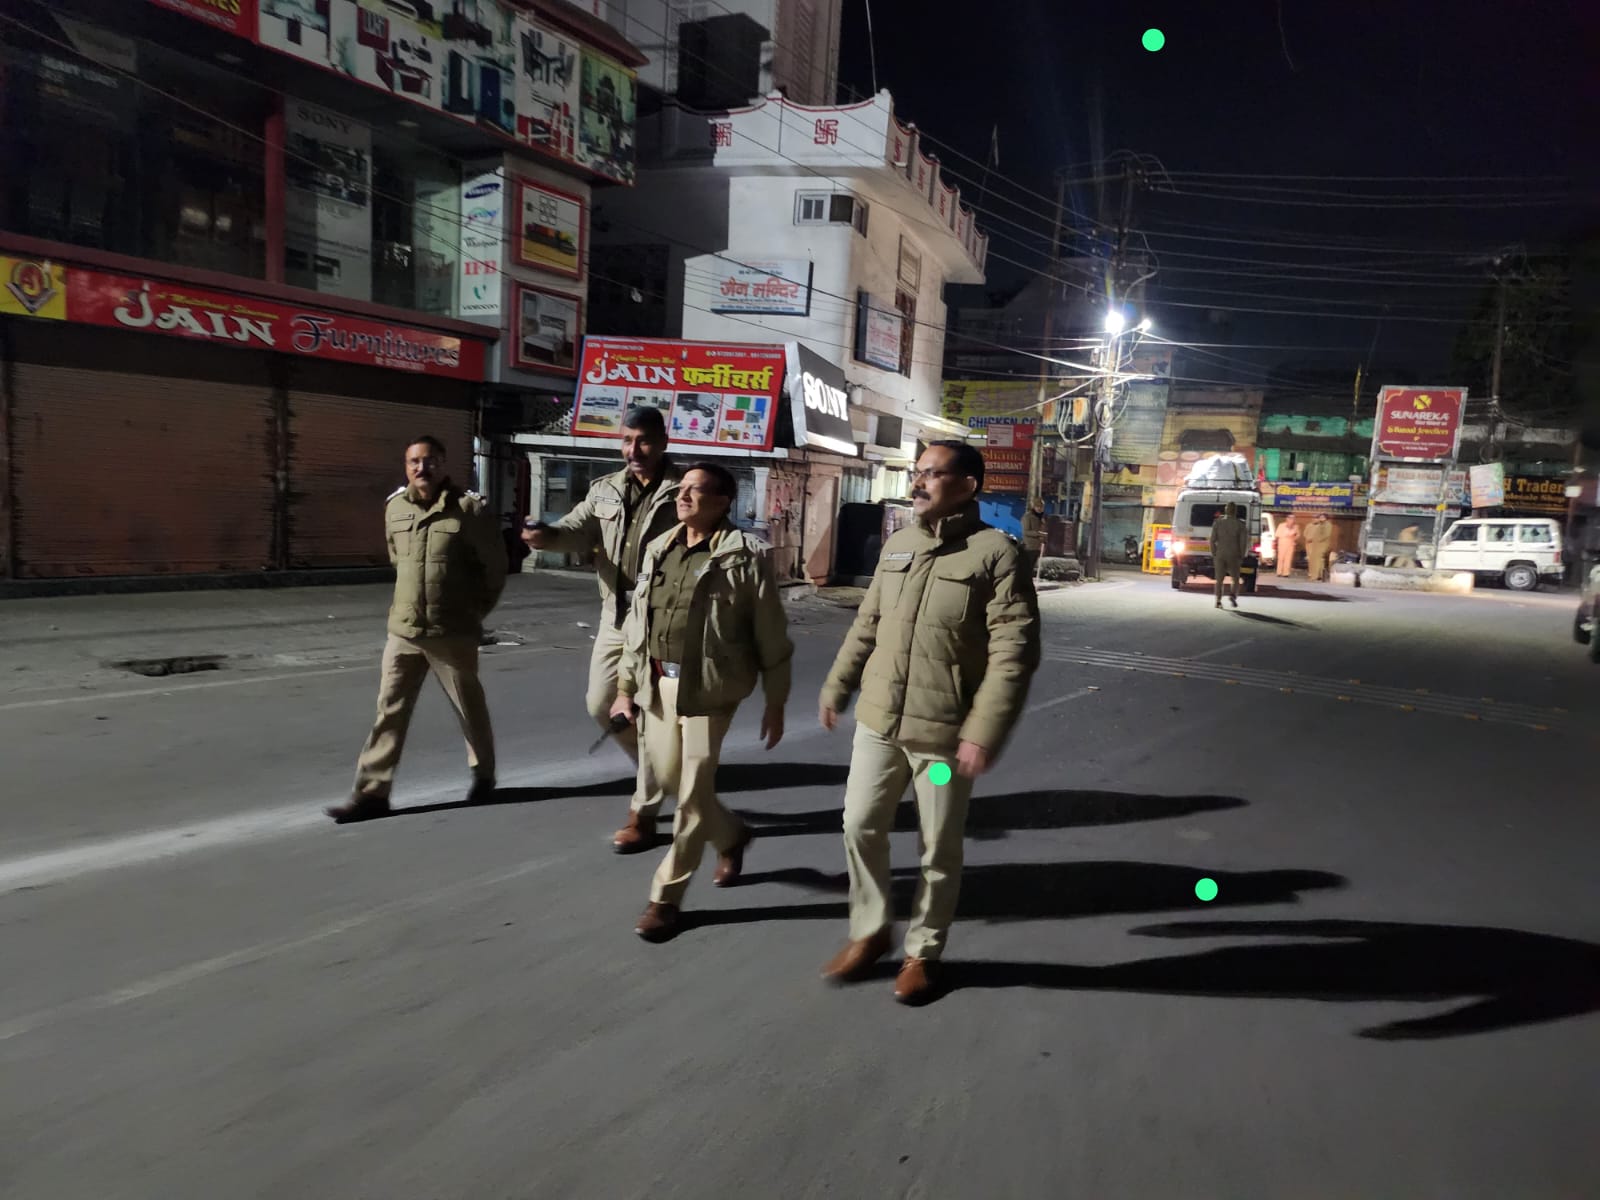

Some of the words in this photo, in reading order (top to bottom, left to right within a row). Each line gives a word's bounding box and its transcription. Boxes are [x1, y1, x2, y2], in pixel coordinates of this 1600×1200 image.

[297, 106, 352, 134] SONY
[464, 260, 497, 275] IFB
[290, 313, 459, 368] Furnitures
[803, 371, 849, 422] SONY
[1517, 478, 1563, 493] Trader
